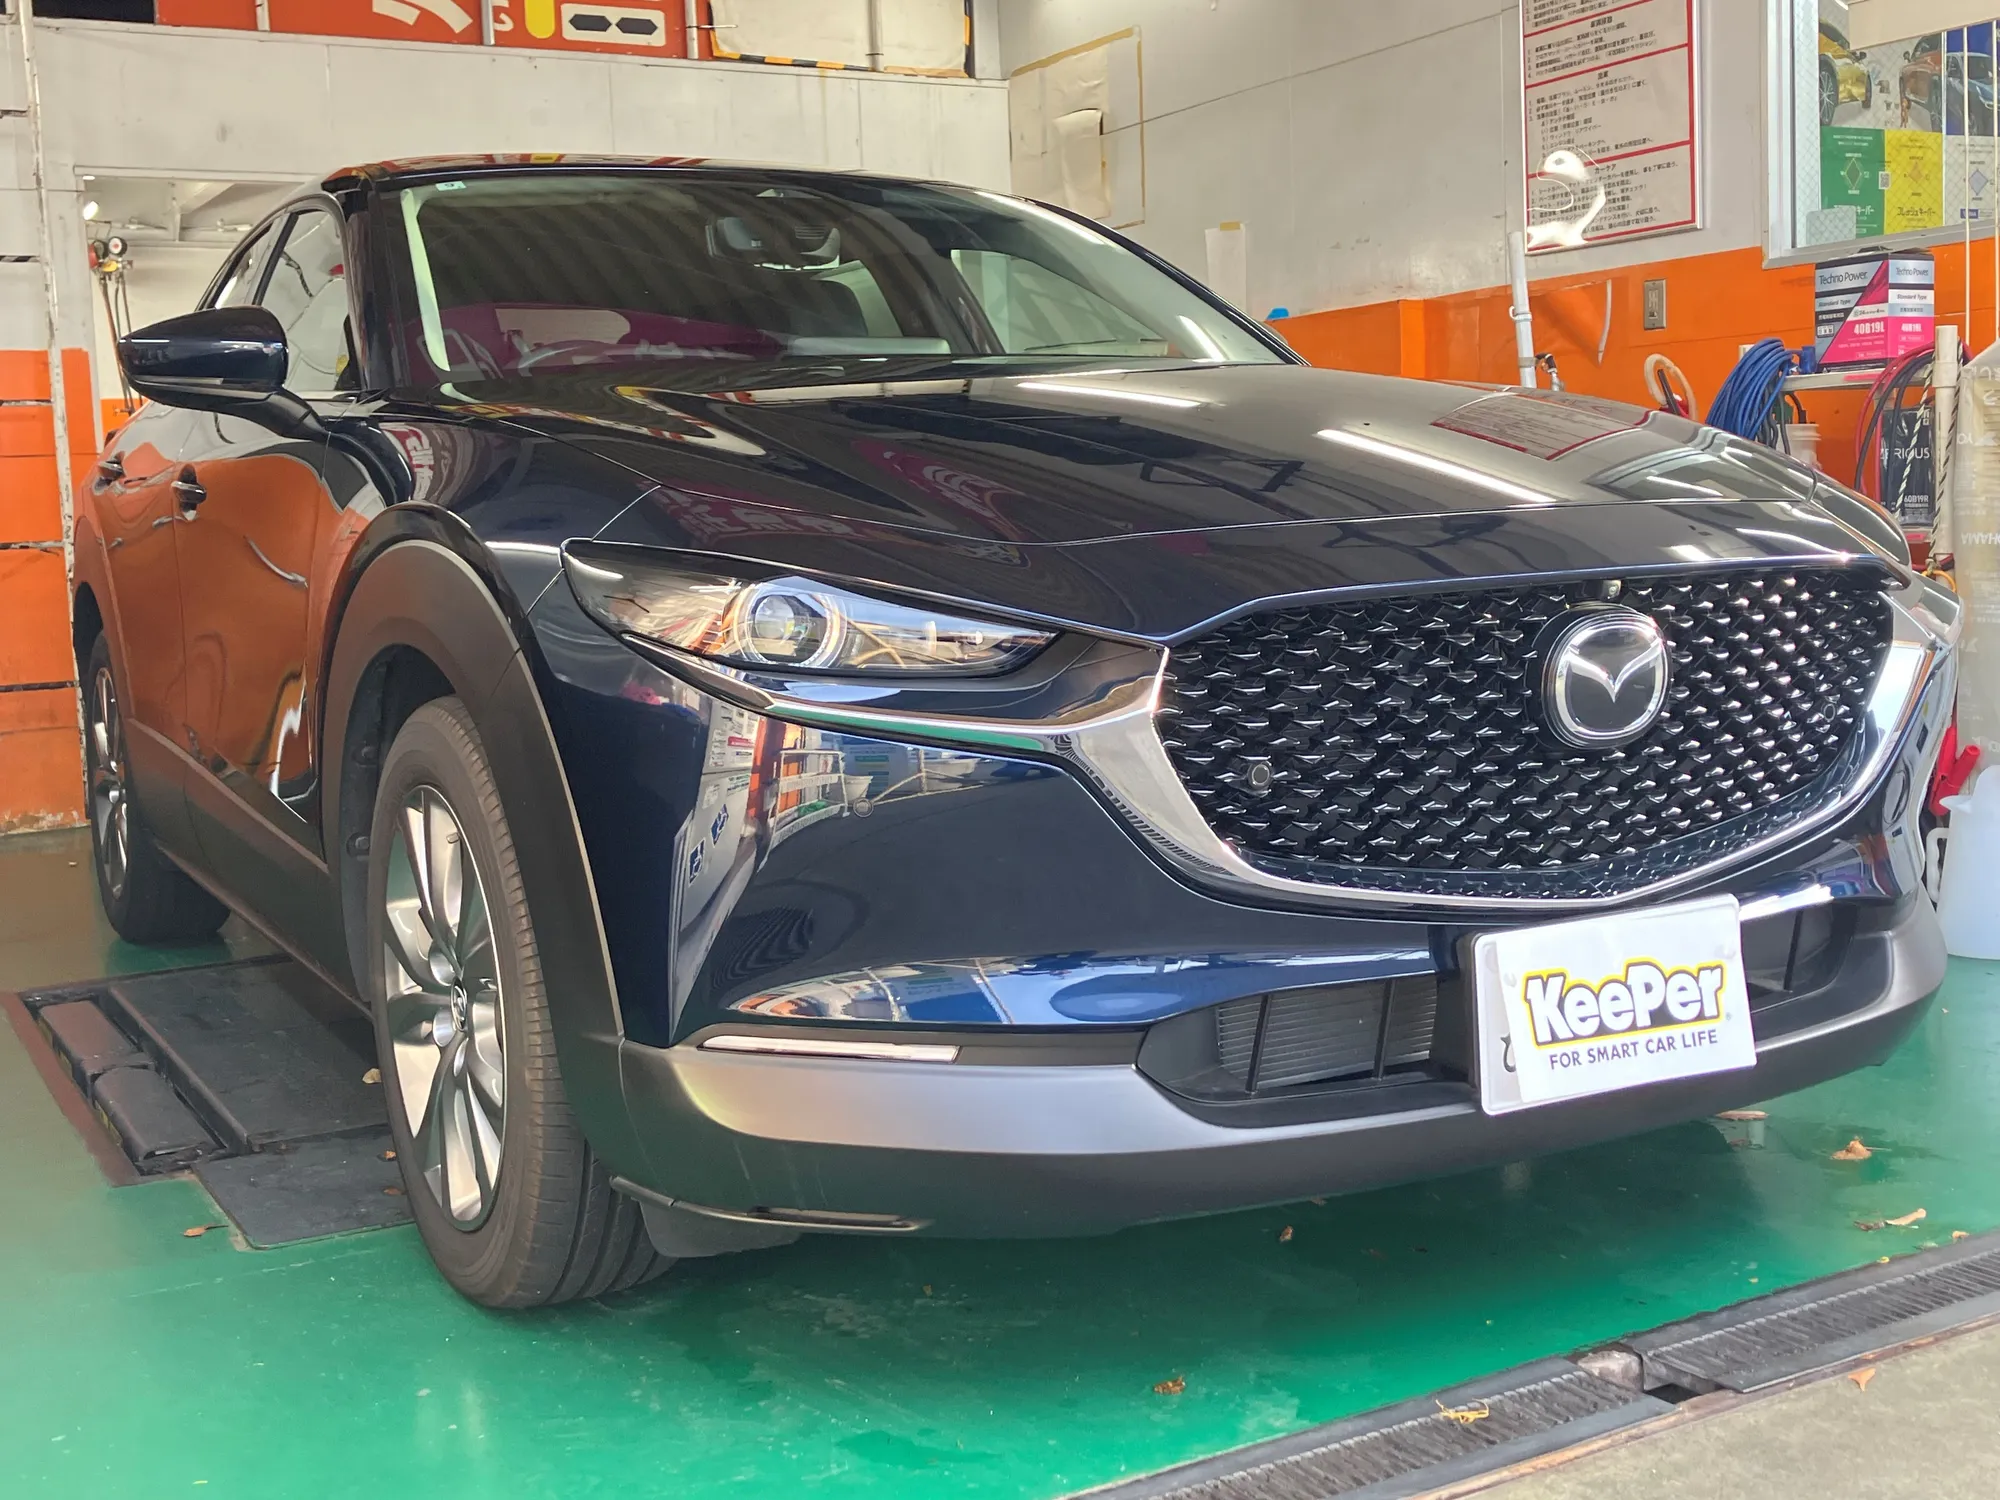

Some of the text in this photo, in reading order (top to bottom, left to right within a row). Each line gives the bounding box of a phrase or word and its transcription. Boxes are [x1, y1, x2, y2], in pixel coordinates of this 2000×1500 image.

[1819, 270, 1868, 285] Techno Power
[1525, 961, 1725, 1046] KeePer
[1549, 1028, 1718, 1071] FOR SMART CAR LIFE
